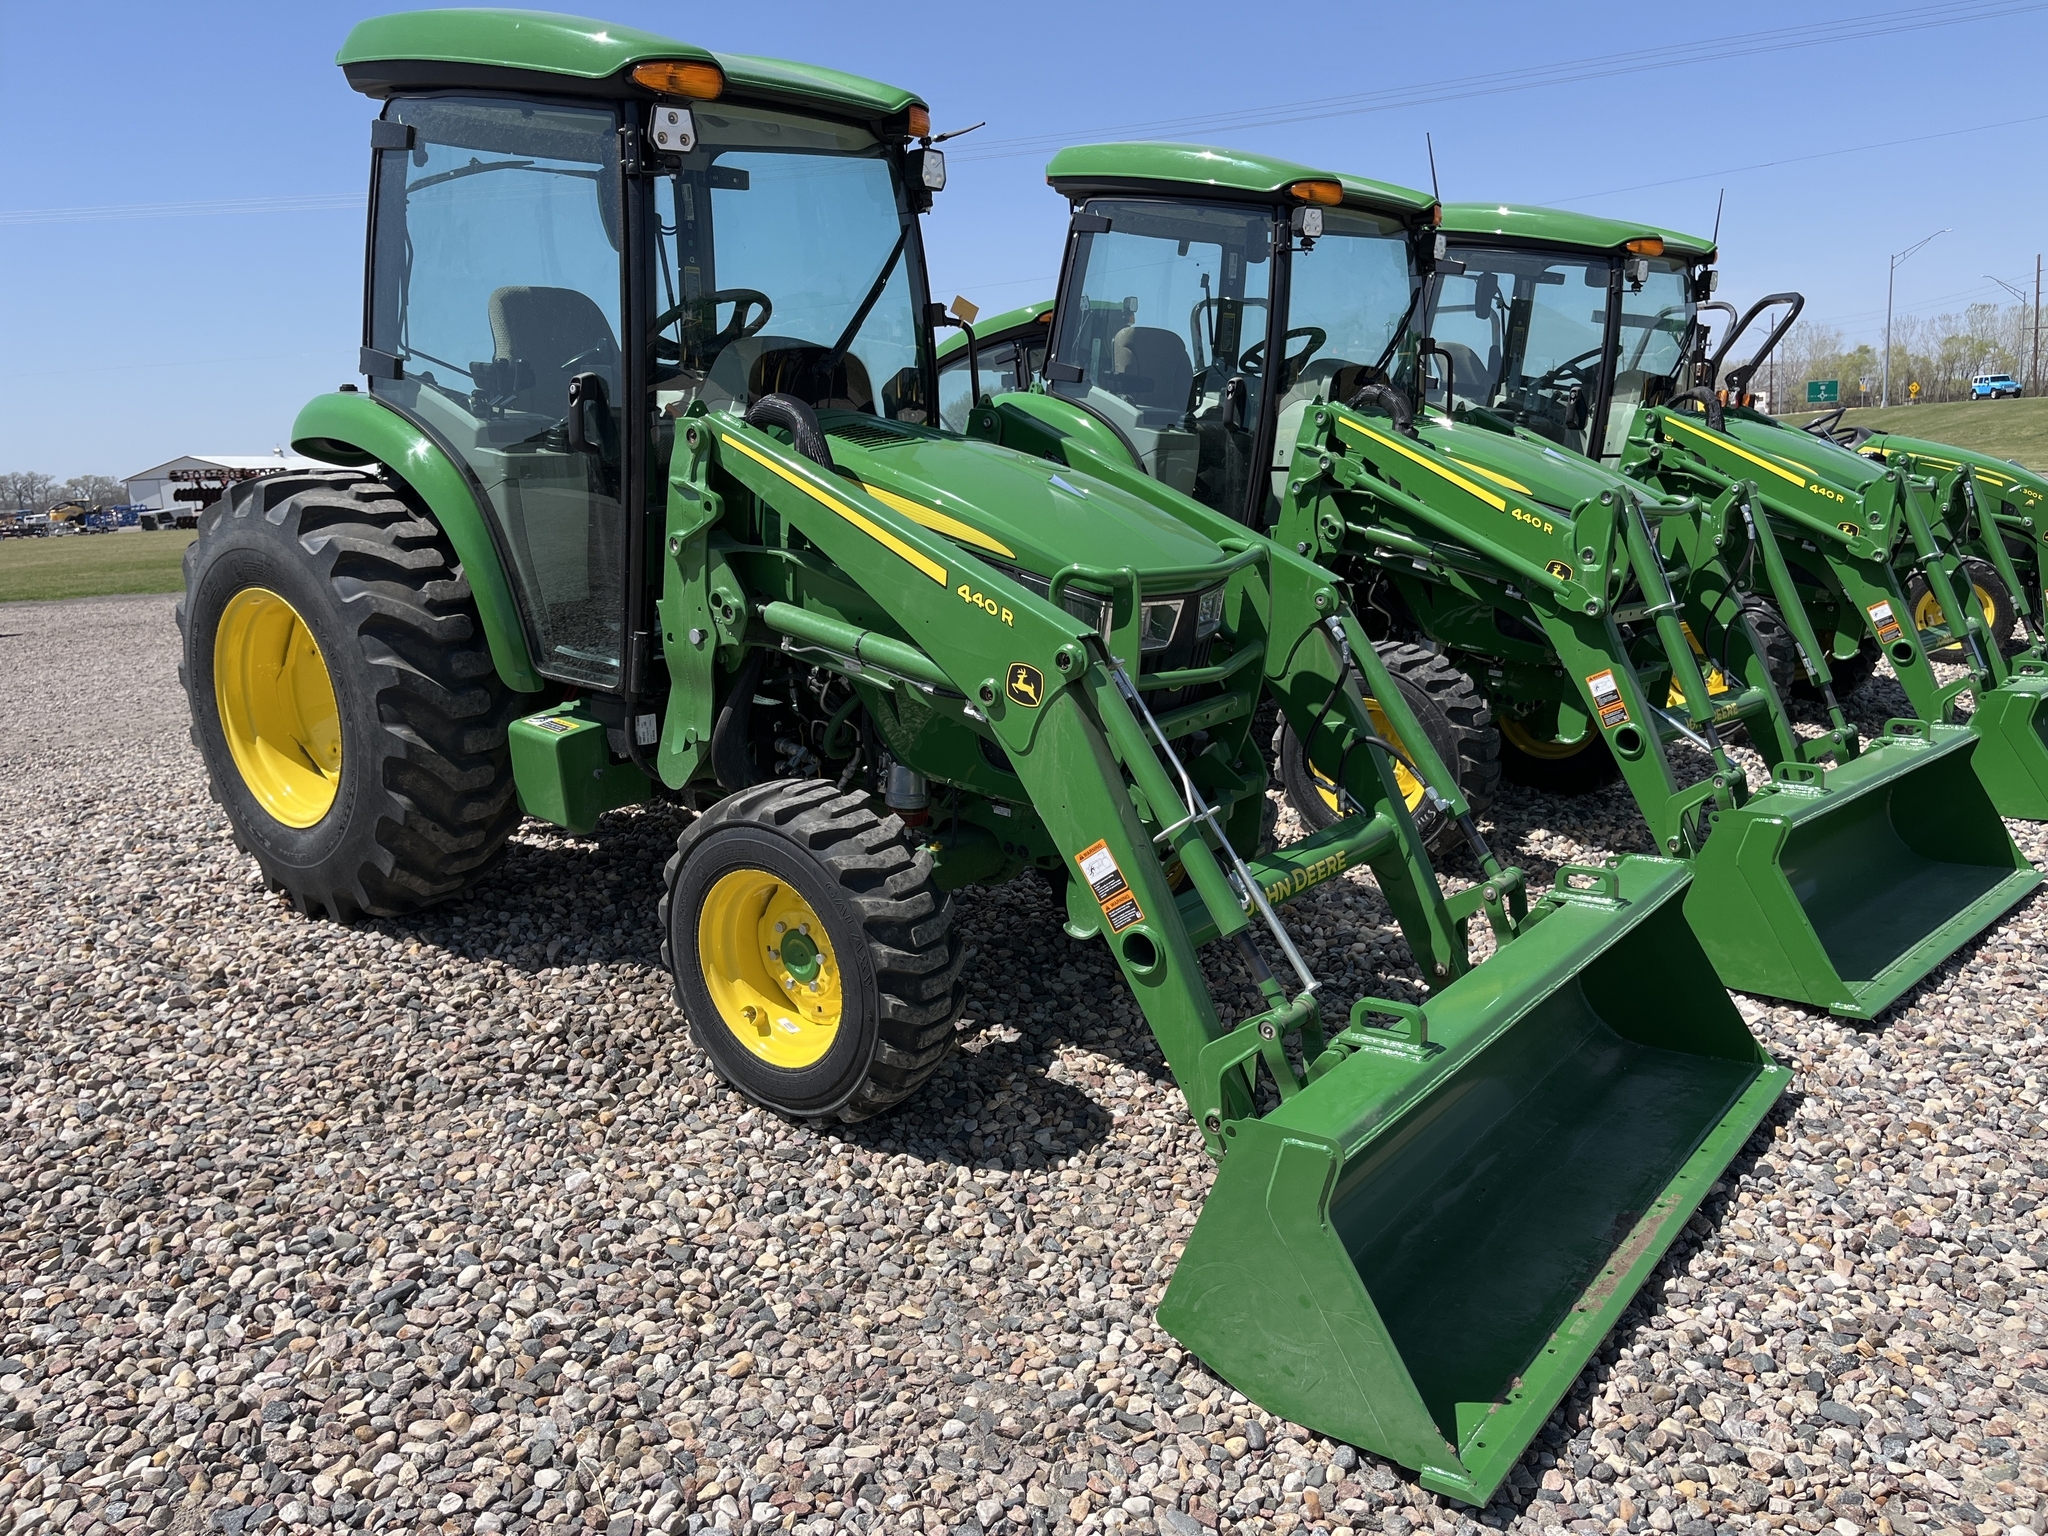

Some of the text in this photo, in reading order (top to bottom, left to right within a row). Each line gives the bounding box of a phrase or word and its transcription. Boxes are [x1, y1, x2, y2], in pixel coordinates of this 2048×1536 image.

[1809, 483, 1845, 503] 440 R
[1511, 507, 1554, 535] 440 R
[957, 583, 1015, 627] 440 R
[1291, 850, 1347, 892] DEERE
